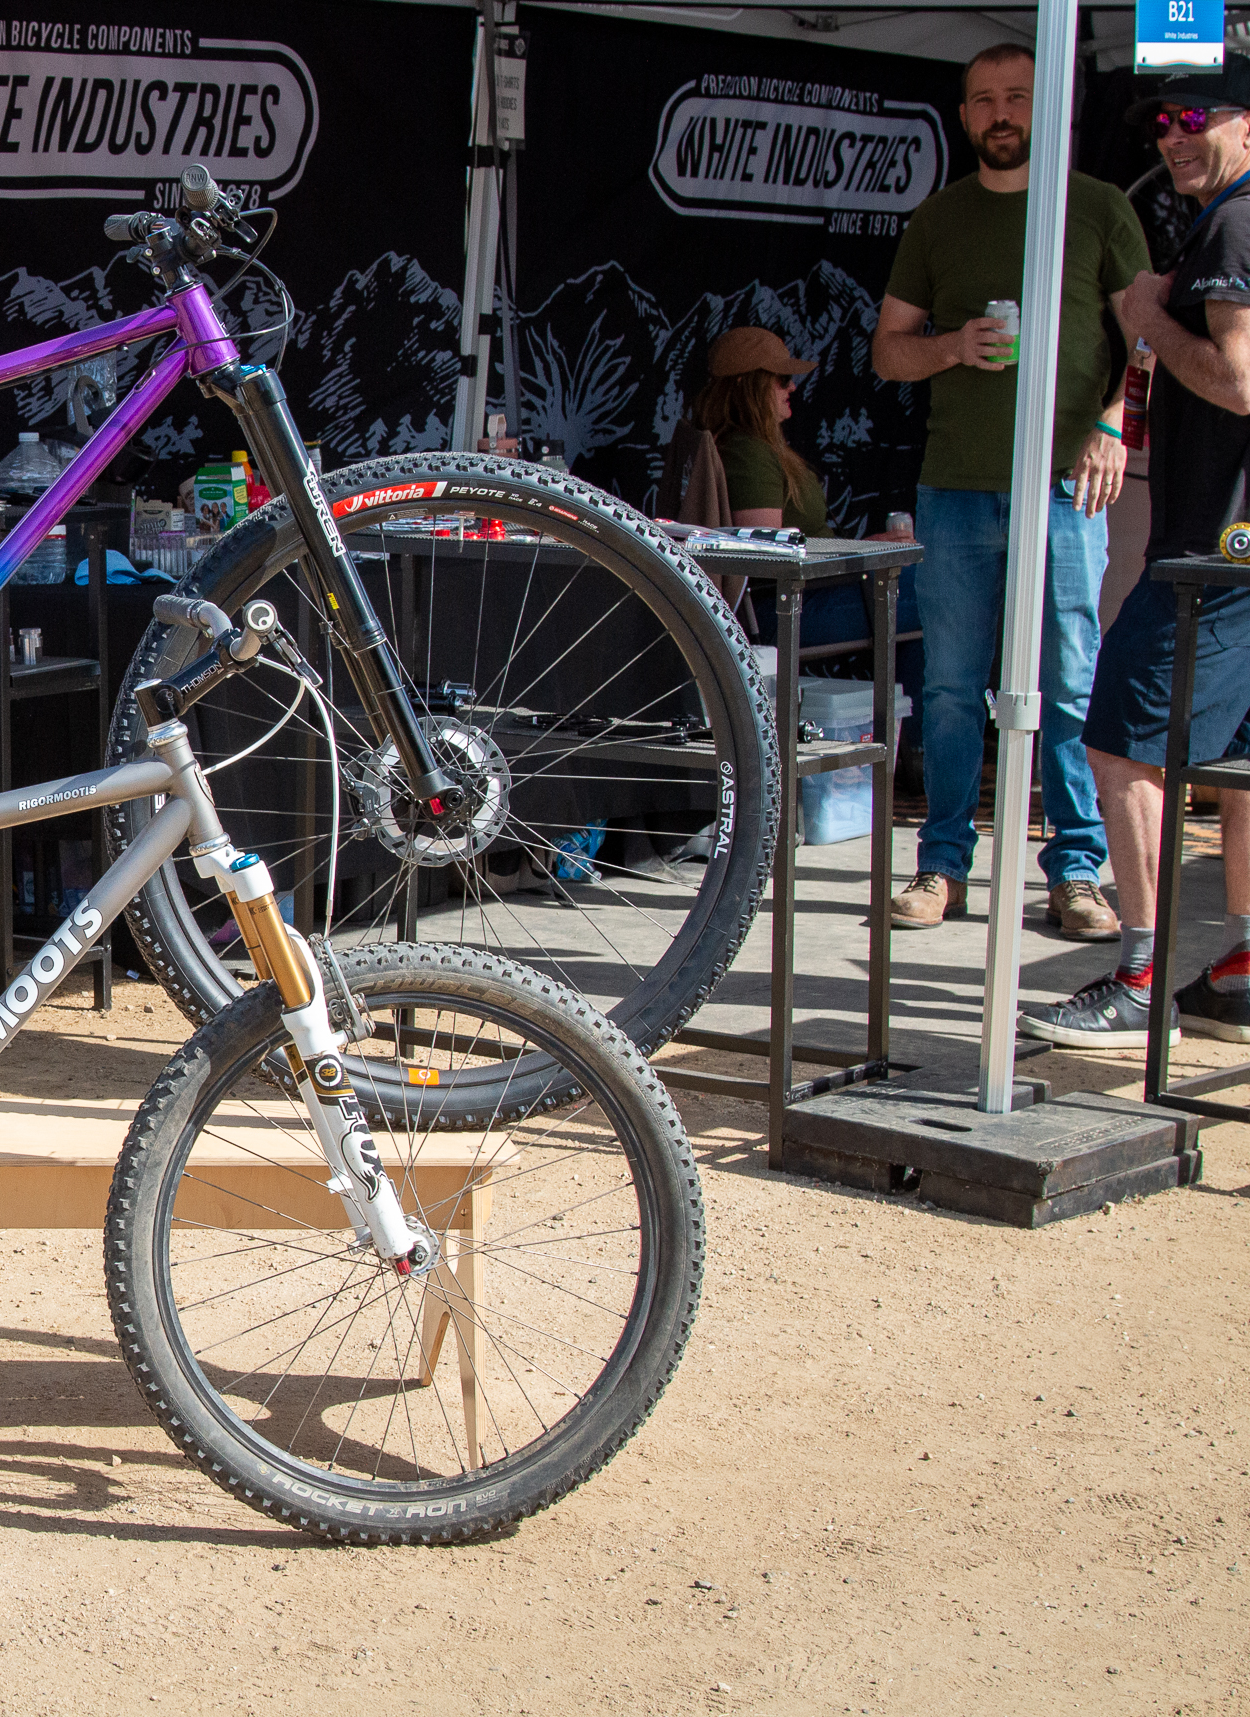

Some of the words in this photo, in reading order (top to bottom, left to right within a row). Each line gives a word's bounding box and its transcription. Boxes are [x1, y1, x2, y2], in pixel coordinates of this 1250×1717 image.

[1168, 1, 1195, 22] B21
[11, 19, 82, 50] BICYCLE
[88, 25, 192, 54] COMPONENTS
[1164, 32, 1177, 40] White
[1177, 32, 1199, 40] Industries
[31, 76, 281, 158] INDUSTRIES
[676, 115, 768, 183] WHITE
[763, 122, 922, 195] INDUSTRIES
[153, 182, 184, 210] SIN
[829, 211, 863, 235] SINCE
[867, 214, 898, 236] 1978
[1191, 276, 1235, 291] Alpinist
[364, 485, 425, 507] vittoria
[449, 486, 506, 499] PEYOTE
[303, 466, 346, 557] WREN
[180, 661, 223, 694] THOMSON
[18, 785, 97, 811] RIGORMOOTIS
[714, 775, 735, 859] ASTRAL
[320, 1068, 337, 1077] 32
[272, 1474, 383, 1517] ROCKET
[405, 1499, 467, 1519] RON
[476, 1490, 496, 1502] EVO
